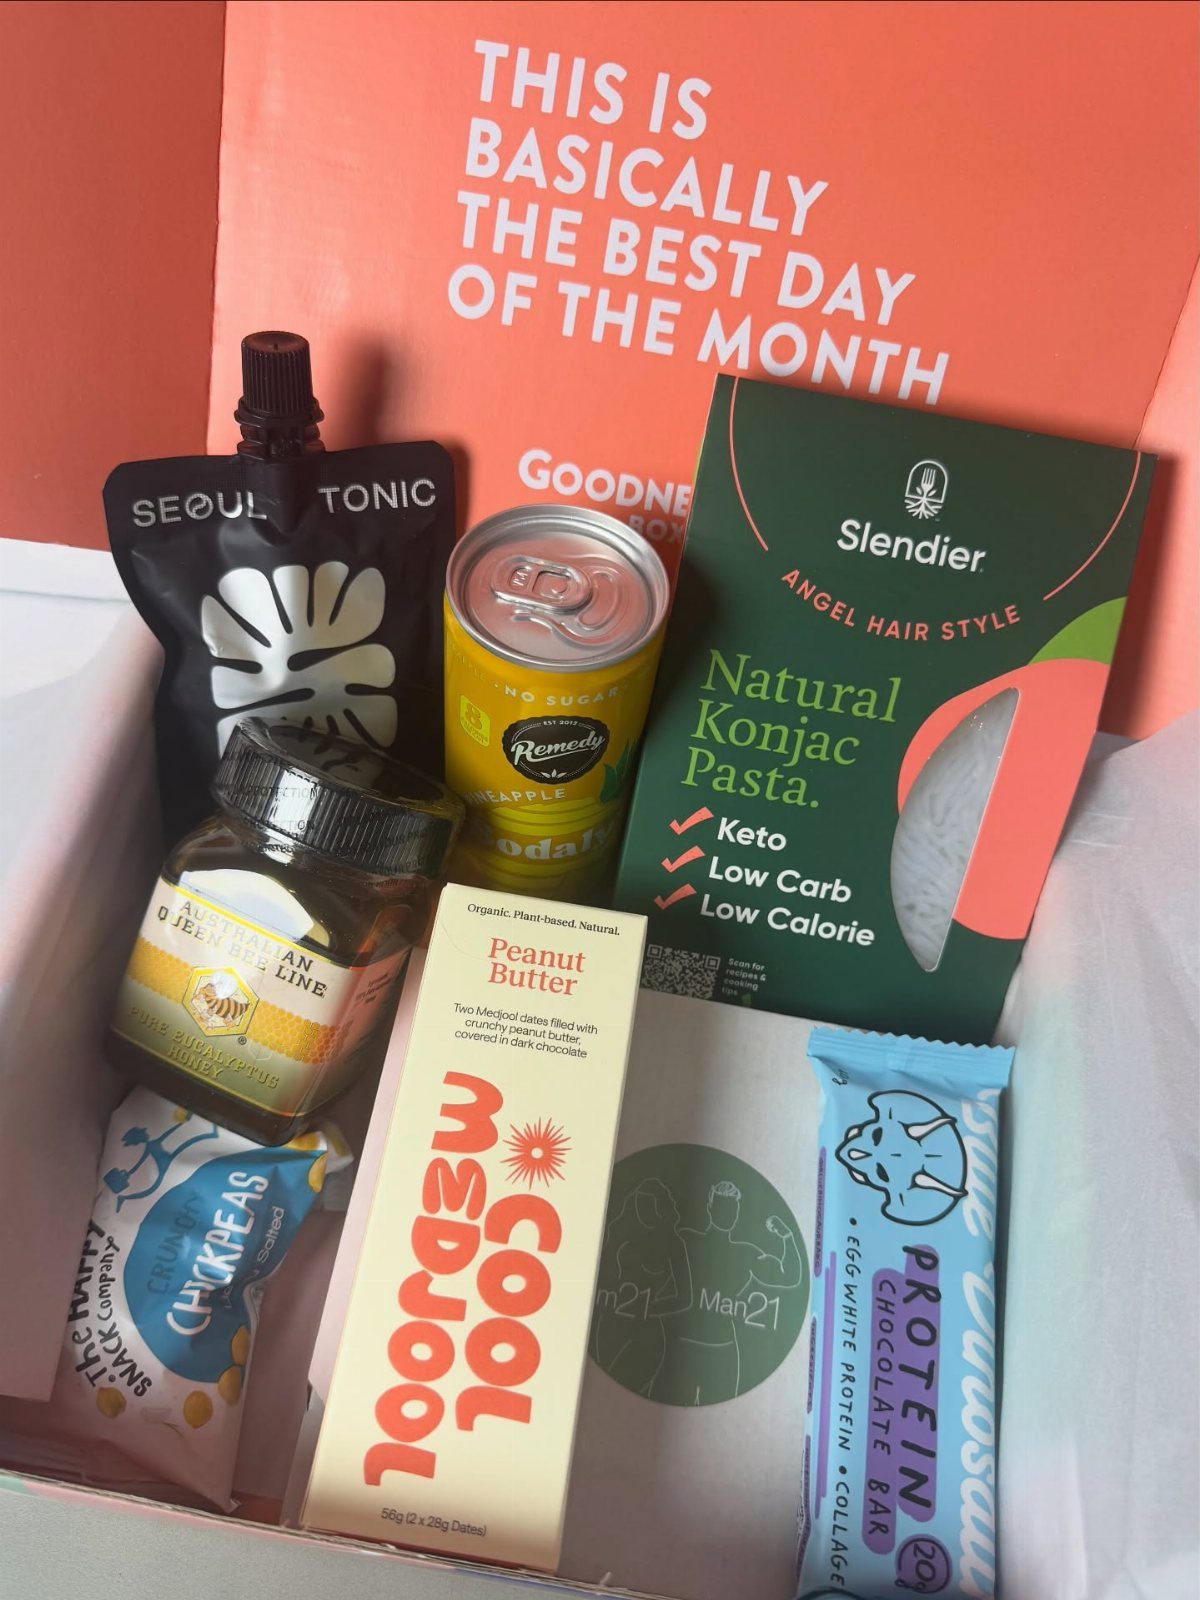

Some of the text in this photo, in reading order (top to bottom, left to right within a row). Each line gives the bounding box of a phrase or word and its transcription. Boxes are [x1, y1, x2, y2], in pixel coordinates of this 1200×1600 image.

[474, 39, 713, 140] THIS IS
[465, 117, 829, 236] BASICALLY
[457, 191, 916, 326] THE BEST DAY
[447, 264, 950, 405] OF THE MONTH
[131, 478, 437, 528] SEOUL TONIC
[517, 449, 692, 518] GOODNE
[628, 514, 684, 544] BOX
[836, 518, 987, 574] Slendier
[780, 569, 1022, 643] ANGEL HAIR STYLE
[504, 683, 620, 706] NO SUGAR
[700, 648, 902, 724] Natural
[510, 730, 606, 766] Remedy
[690, 699, 861, 768] Konjac
[680, 746, 820, 809] Pasta.
[716, 816, 788, 852] Keto
[708, 856, 852, 904] Low Carb
[179, 899, 315, 974] AUSTRALIAN
[467, 903, 621, 936] Organic. Plant-based. Natural.
[701, 893, 876, 948] Low Calorie
[156, 905, 222, 952] QUEEN
[227, 940, 269, 972] BEE
[275, 965, 328, 999] LINE
[487, 937, 587, 973] Peanut
[487, 961, 578, 996] Butter
[726, 968, 758, 980] recipes
[728, 958, 765, 971] Scan for
[722, 986, 738, 996] tips
[724, 979, 759, 991] cooking
[453, 1003, 598, 1035] Two Medjool dates filled with
[454, 1029, 588, 1059] covered in dark chocolate
[465, 1019, 582, 1046] crunchy peanut butter,
[126, 1005, 281, 1091] PURE EUCALYPTUS
[167, 1045, 225, 1082] HONEY
[166, 1171, 270, 1337] CHICKPEAS
[256, 1205, 285, 1264] Salted
[363, 1071, 504, 1487] MEDJOOL
[597, 1281, 651, 1321] m21
[455, 1193, 563, 1433] COOL
[699, 1287, 780, 1331] Man21
[72, 1325, 108, 1388] The
[98, 1321, 152, 1397] SNACK
[898, 1244, 942, 1509] PROTEIN
[838, 1361, 857, 1451] PROTEIN
[868, 1278, 896, 1535] CHOCOLATE BAR
[380, 1507, 487, 1537] 56g (2 x 28g Dates)
